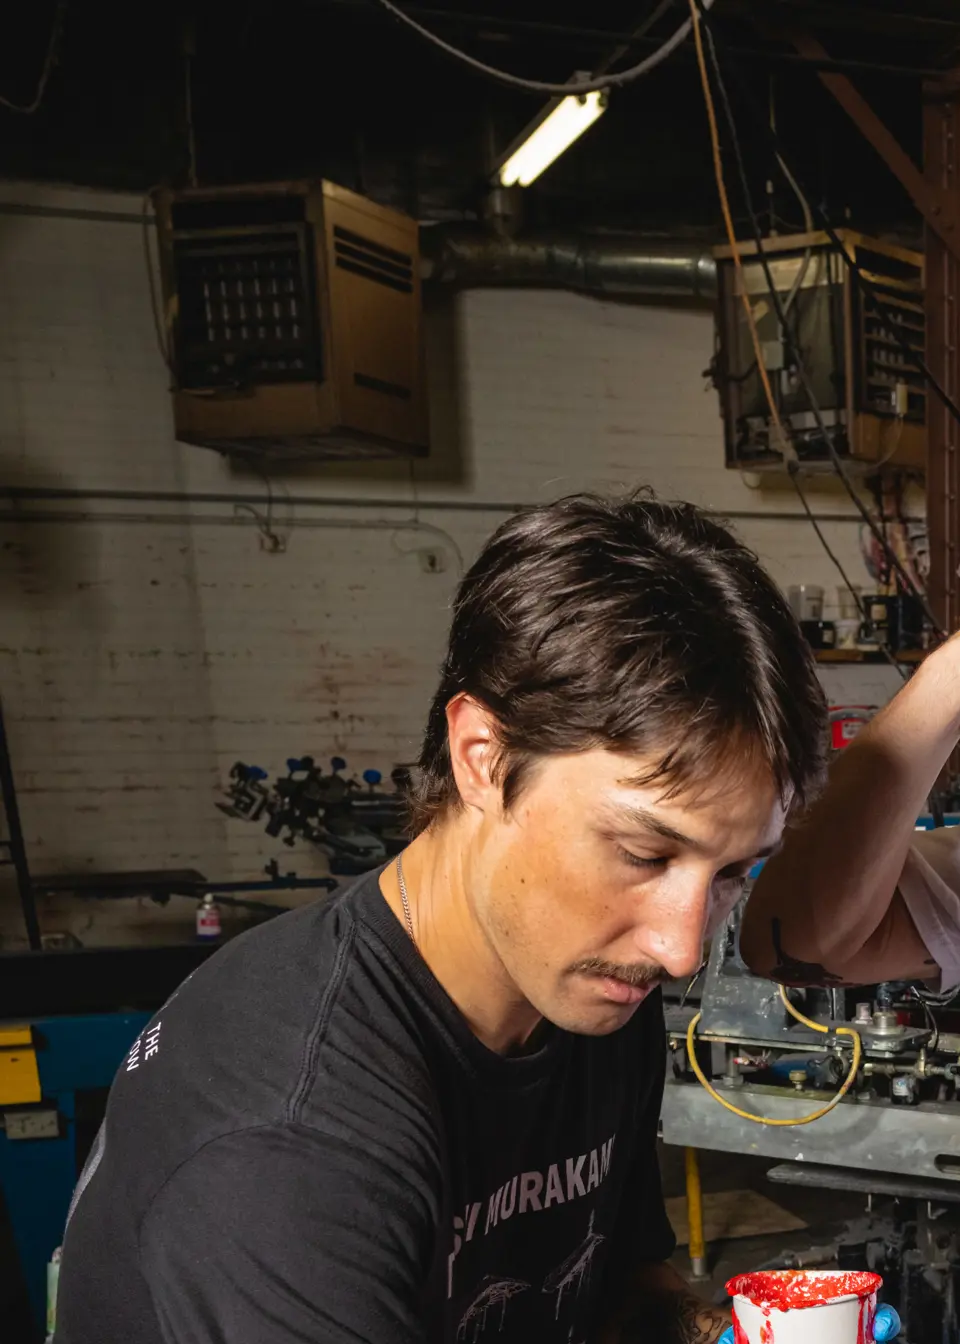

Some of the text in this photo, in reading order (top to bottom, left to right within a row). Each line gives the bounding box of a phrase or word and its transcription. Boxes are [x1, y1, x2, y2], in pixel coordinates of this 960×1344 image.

[126, 1031, 142, 1072] OW
[144, 1021, 162, 1061] THE
[484, 1134, 616, 1236] MURAKAM
